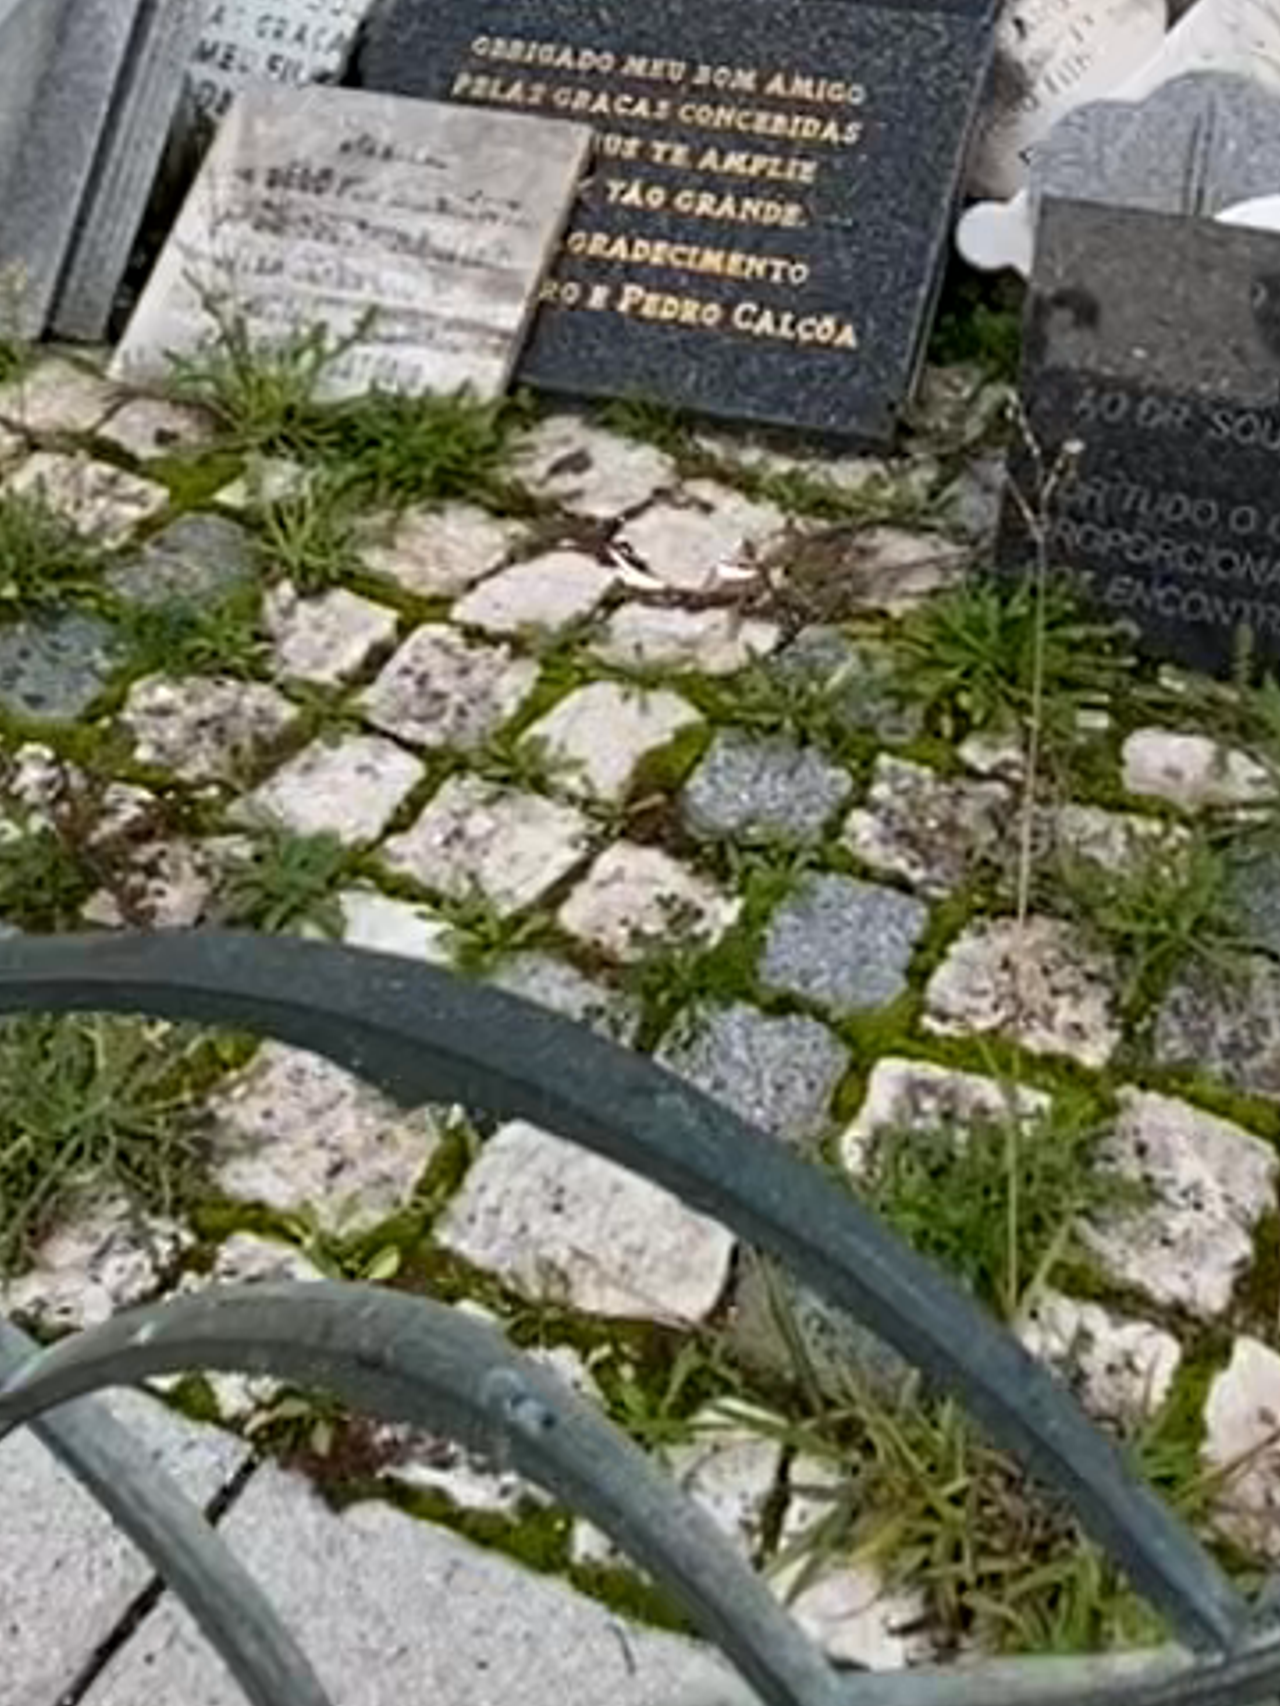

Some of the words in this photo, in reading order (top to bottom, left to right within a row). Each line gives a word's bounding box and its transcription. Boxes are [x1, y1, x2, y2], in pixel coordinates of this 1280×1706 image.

[450, 71, 548, 106] PELAS
[471, 35, 616, 73] OBRIGADO
[621, 54, 686, 83] MEU
[694, 63, 759, 90] BOM
[765, 69, 867, 106] AMIGO
[651, 140, 690, 168] TE
[697, 148, 819, 184] AMPLIE
[1121, 481, 1220, 527] TUDO
[1228, 505, 1258, 532] O
